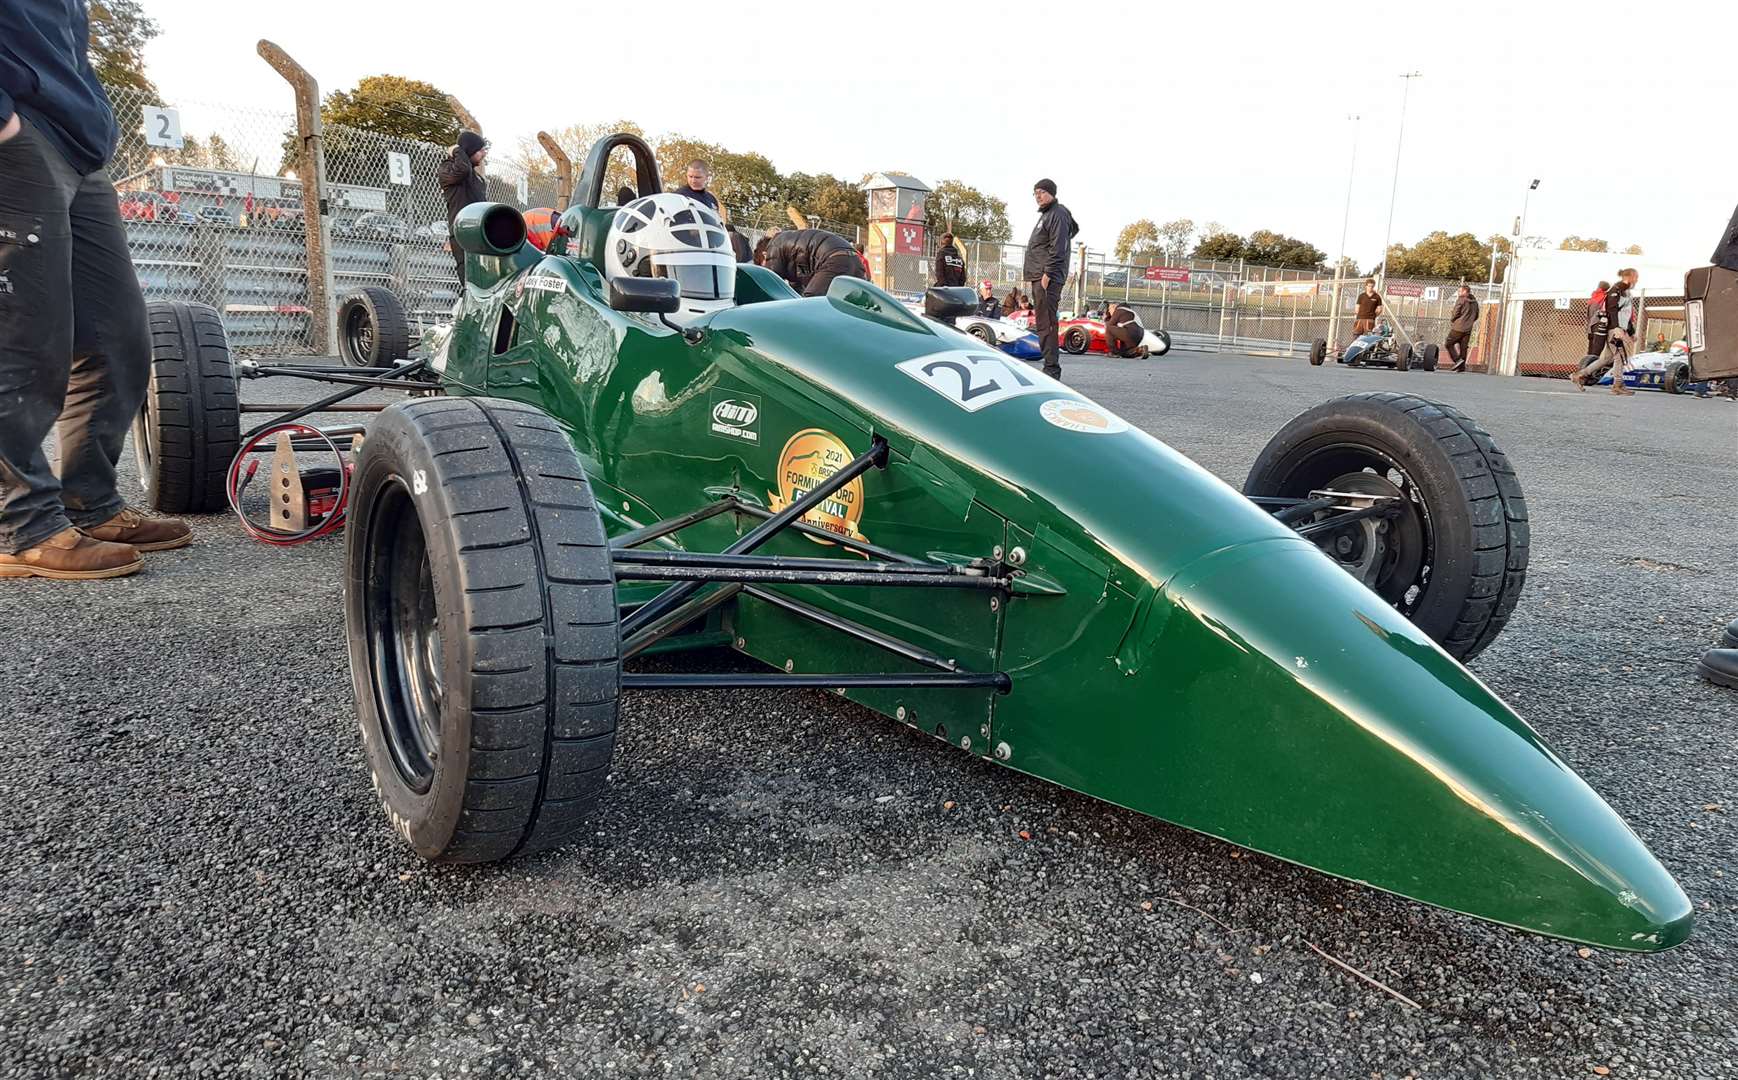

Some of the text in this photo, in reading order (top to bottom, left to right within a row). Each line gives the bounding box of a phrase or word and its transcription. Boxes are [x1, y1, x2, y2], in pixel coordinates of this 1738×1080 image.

[156, 114, 171, 139] 2
[396, 158, 405, 178] 3
[1007, 270, 1015, 280] 10
[538, 279, 565, 290] Foster
[1428, 289, 1436, 298] 11
[1558, 298, 1568, 307] 12
[921, 355, 1034, 401] 27
[826, 449, 843, 463] 2021
[819, 467, 833, 477] BRSC
[786, 471, 854, 503] FORMU ORD
